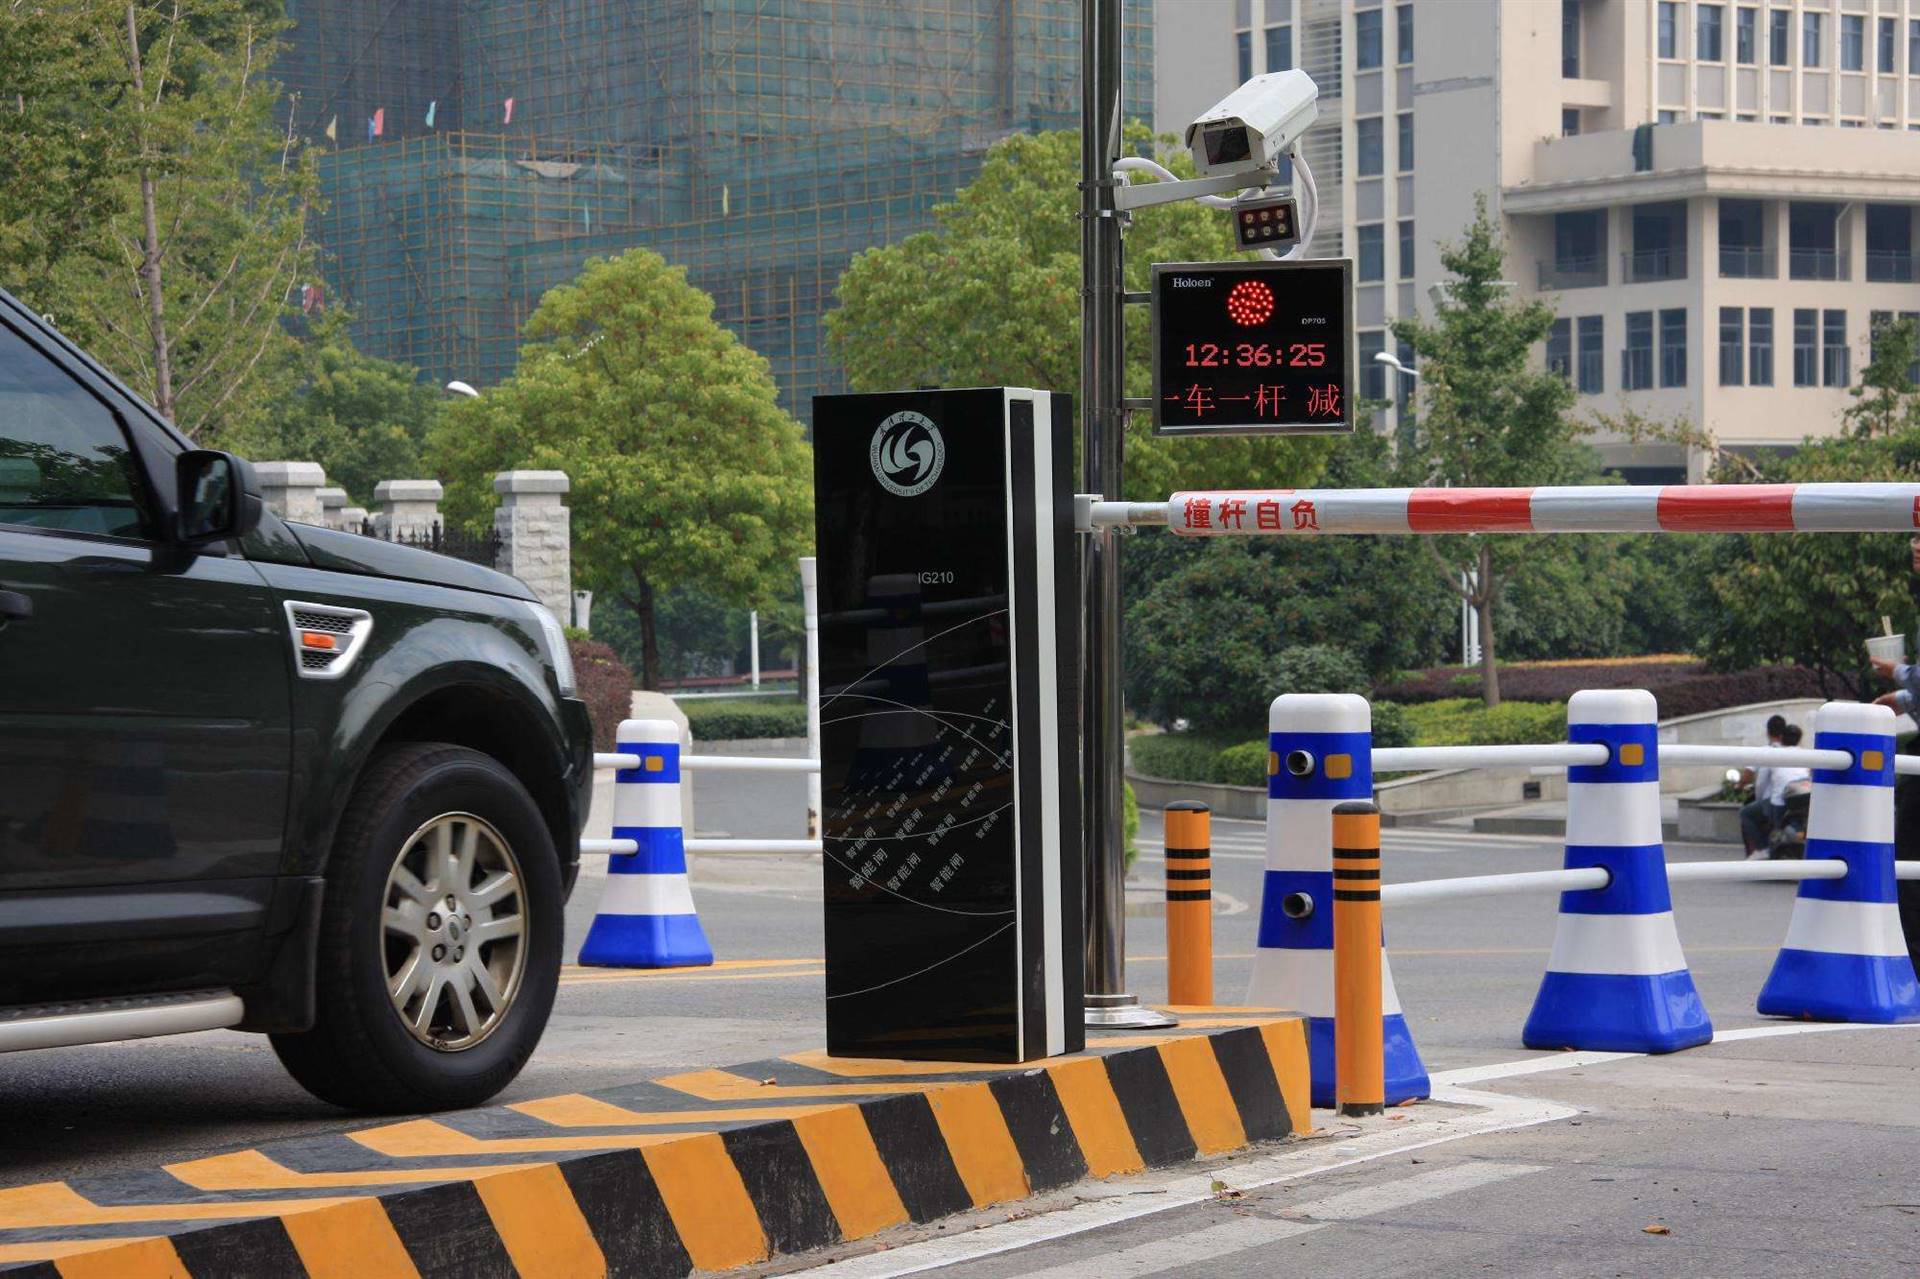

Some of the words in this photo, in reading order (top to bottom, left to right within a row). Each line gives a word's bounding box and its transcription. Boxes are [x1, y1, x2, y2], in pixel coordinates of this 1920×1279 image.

[1185, 344, 1326, 367] 12:36:25
[1184, 498, 1320, 530] 撞杆自负
[917, 572, 954, 584] IG210
[850, 848, 888, 890] 智能闸
[887, 852, 922, 892] 智能闸
[929, 852, 965, 893] 智能闸
